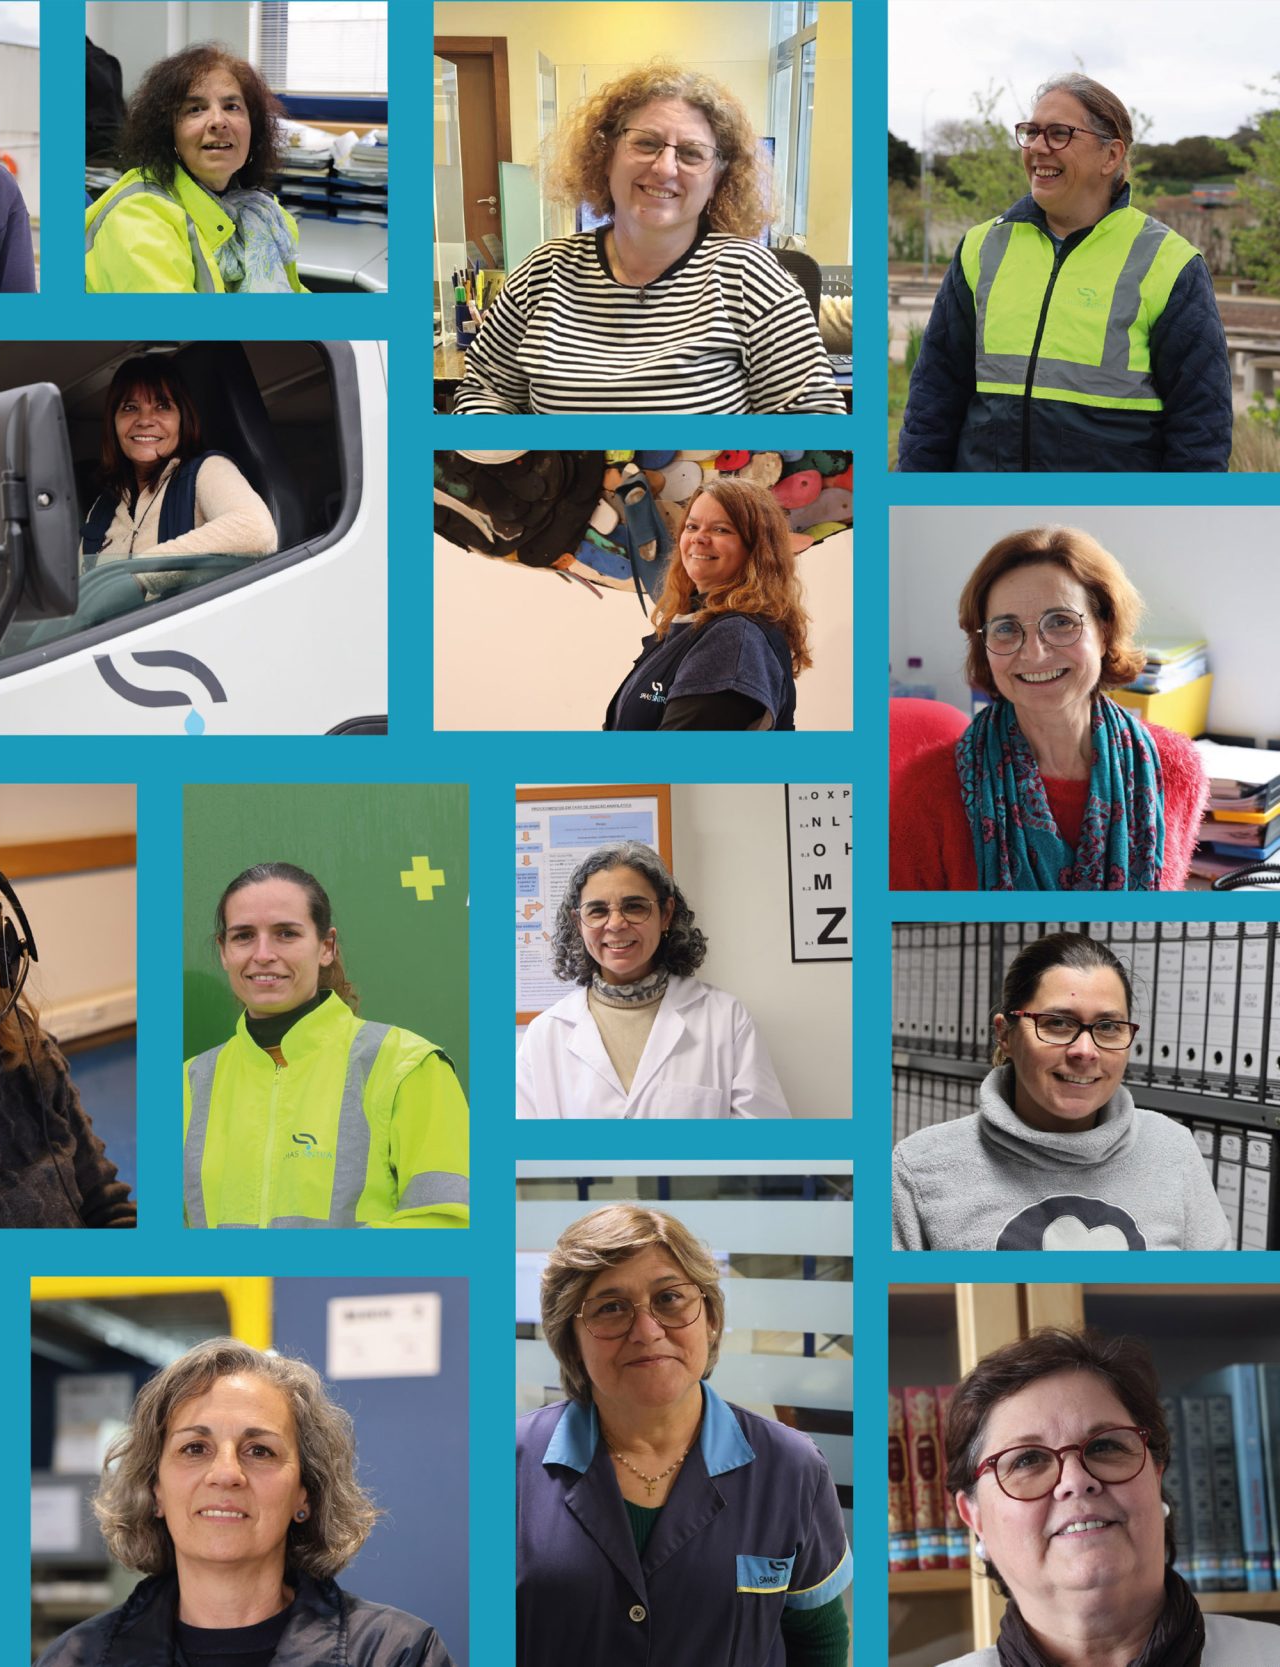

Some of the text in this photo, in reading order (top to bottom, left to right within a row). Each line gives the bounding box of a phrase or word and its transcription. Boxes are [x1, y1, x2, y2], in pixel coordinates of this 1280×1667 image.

[810, 791, 819, 800] O
[827, 790, 834, 799] X
[842, 790, 850, 799] P
[811, 816, 822, 828] N
[832, 815, 841, 827] L
[813, 843, 827, 857] O
[814, 873, 832, 891] M
[816, 906, 848, 945] Z
